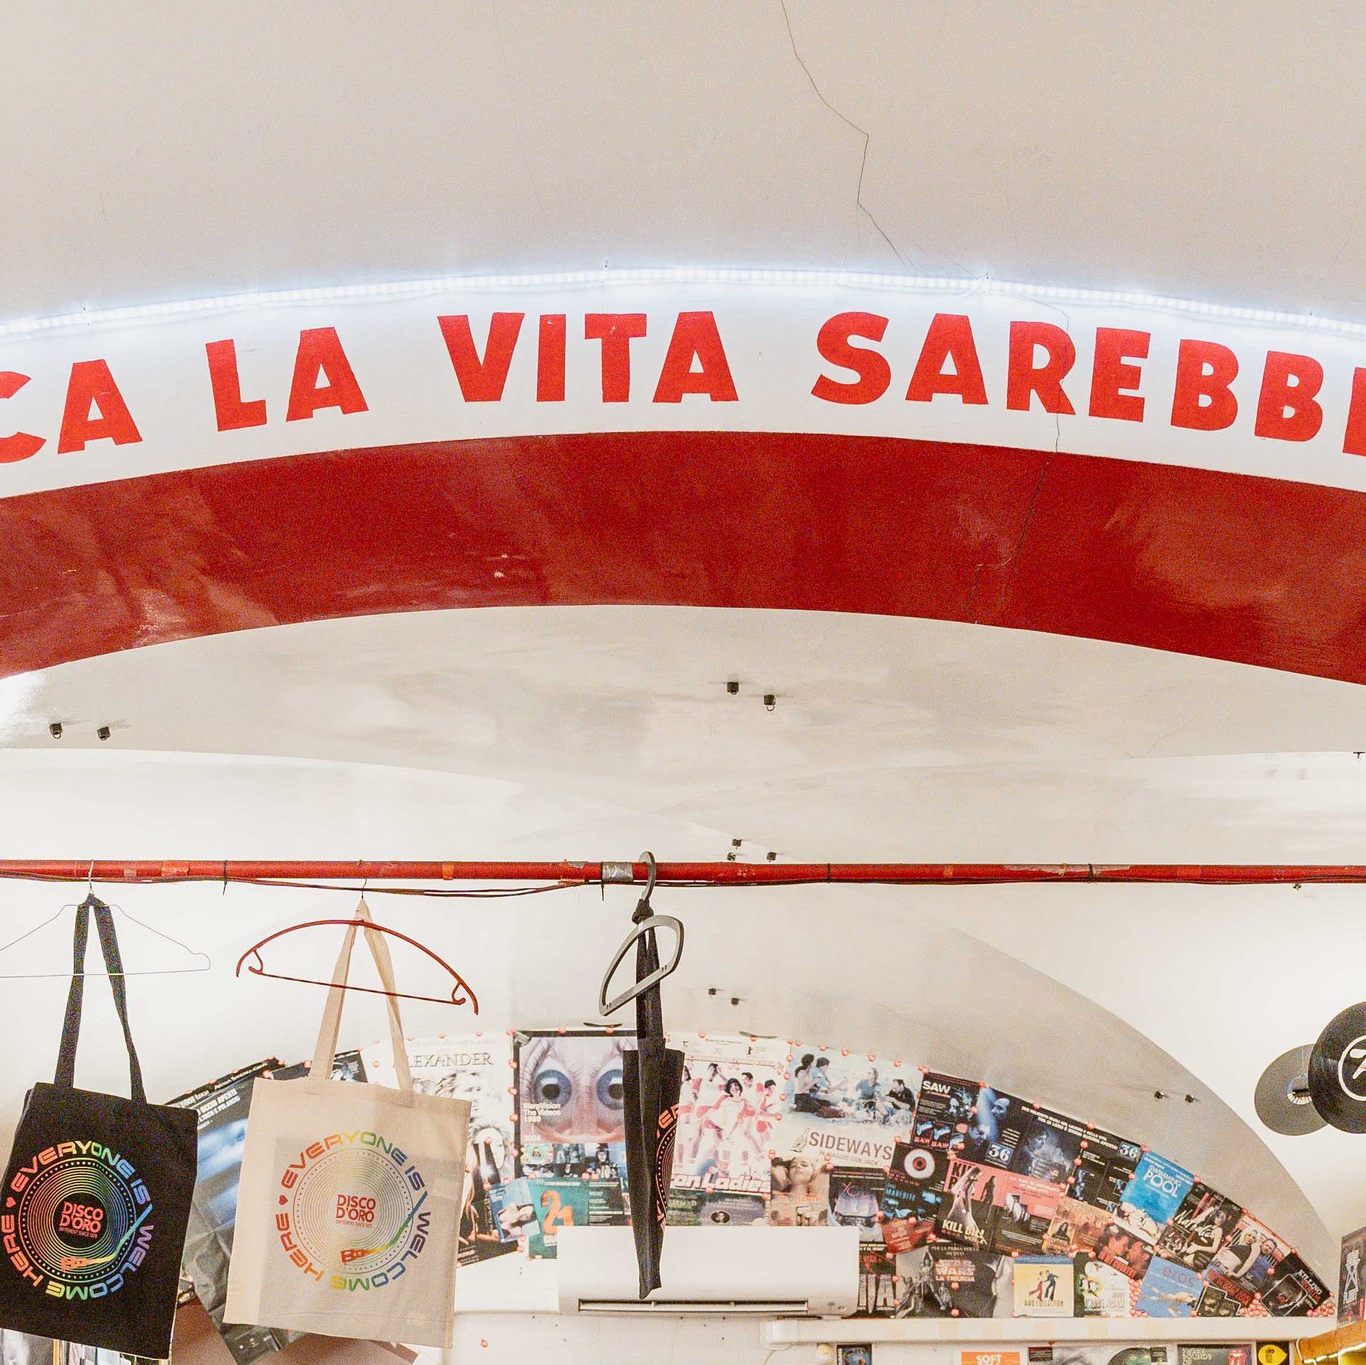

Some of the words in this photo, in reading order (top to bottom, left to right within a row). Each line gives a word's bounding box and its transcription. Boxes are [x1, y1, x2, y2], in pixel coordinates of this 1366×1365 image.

[205, 327, 369, 432] LA
[437, 310, 739, 404] VITA
[922, 1080, 951, 1095] SAW
[809, 1131, 893, 1161] SIDEWAYS
[987, 1143, 1010, 1162] 36
[1119, 1143, 1139, 1159] 36
[10, 1140, 137, 1193] EVERYONE
[280, 1130, 408, 1189] EVERYONE
[404, 1165, 426, 1191] IS
[1143, 1169, 1178, 1198] POOL
[129, 1178, 151, 1205] IS
[336, 1194, 377, 1211] DISCO
[59, 1214, 102, 1234] D'ORO
[62, 1202, 104, 1221] DISCO
[335, 1206, 375, 1223] D'ORO
[942, 1219, 970, 1235] KILL
[0, 1214, 44, 1287] HERE
[275, 1212, 325, 1282] HERE
[329, 1211, 432, 1292] WELCOME
[45, 1224, 155, 1301] WELCOME
[935, 1266, 976, 1276] WARS
[975, 1354, 1003, 1364] SOFT
